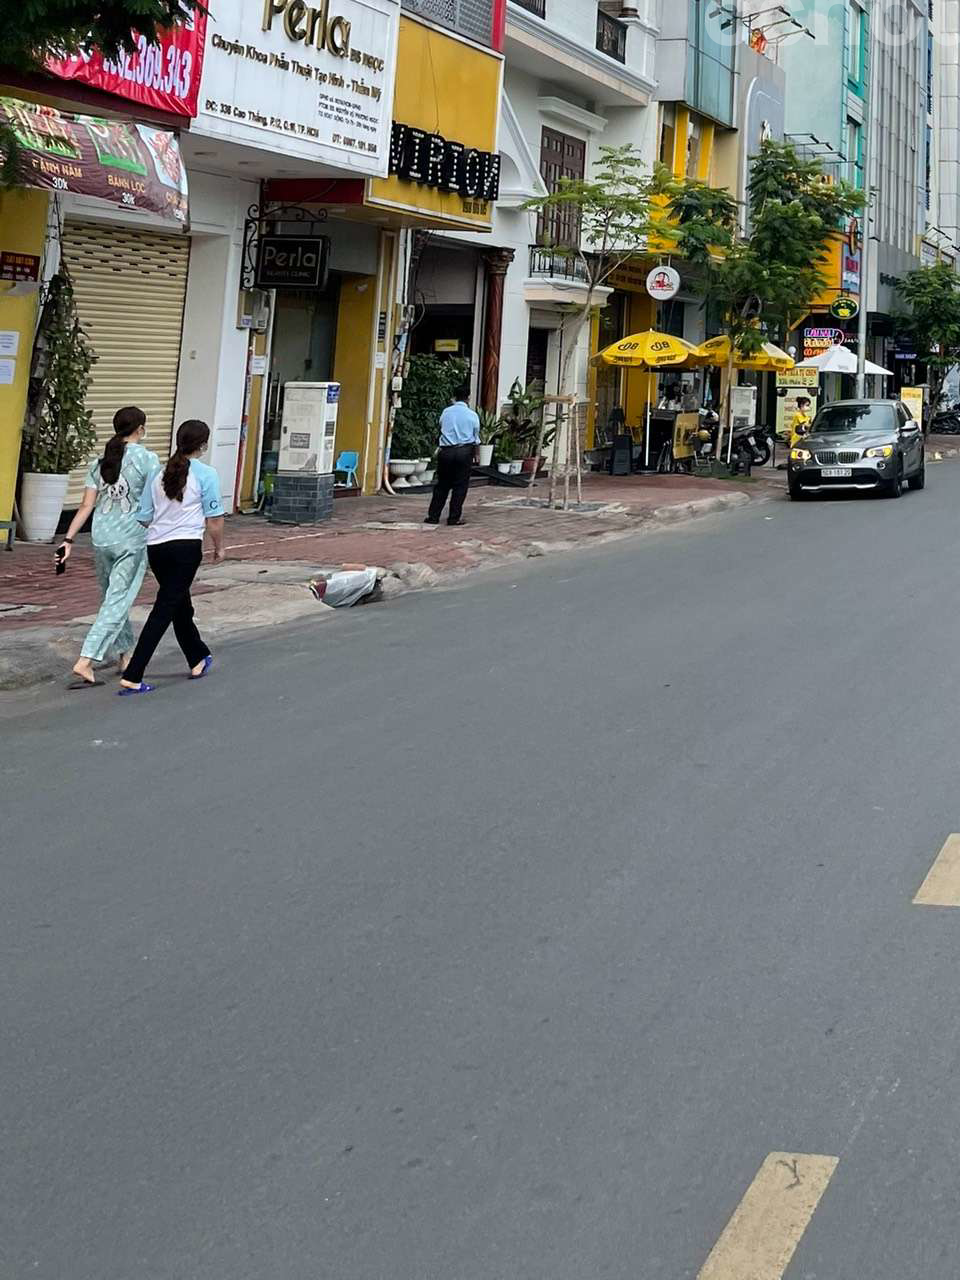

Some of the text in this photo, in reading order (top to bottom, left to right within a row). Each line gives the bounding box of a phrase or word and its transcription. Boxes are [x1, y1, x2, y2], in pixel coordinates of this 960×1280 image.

[245, 45, 268, 63] Khoa
[233, 107, 246, 119] Cao
[264, 246, 317, 267] Perla
